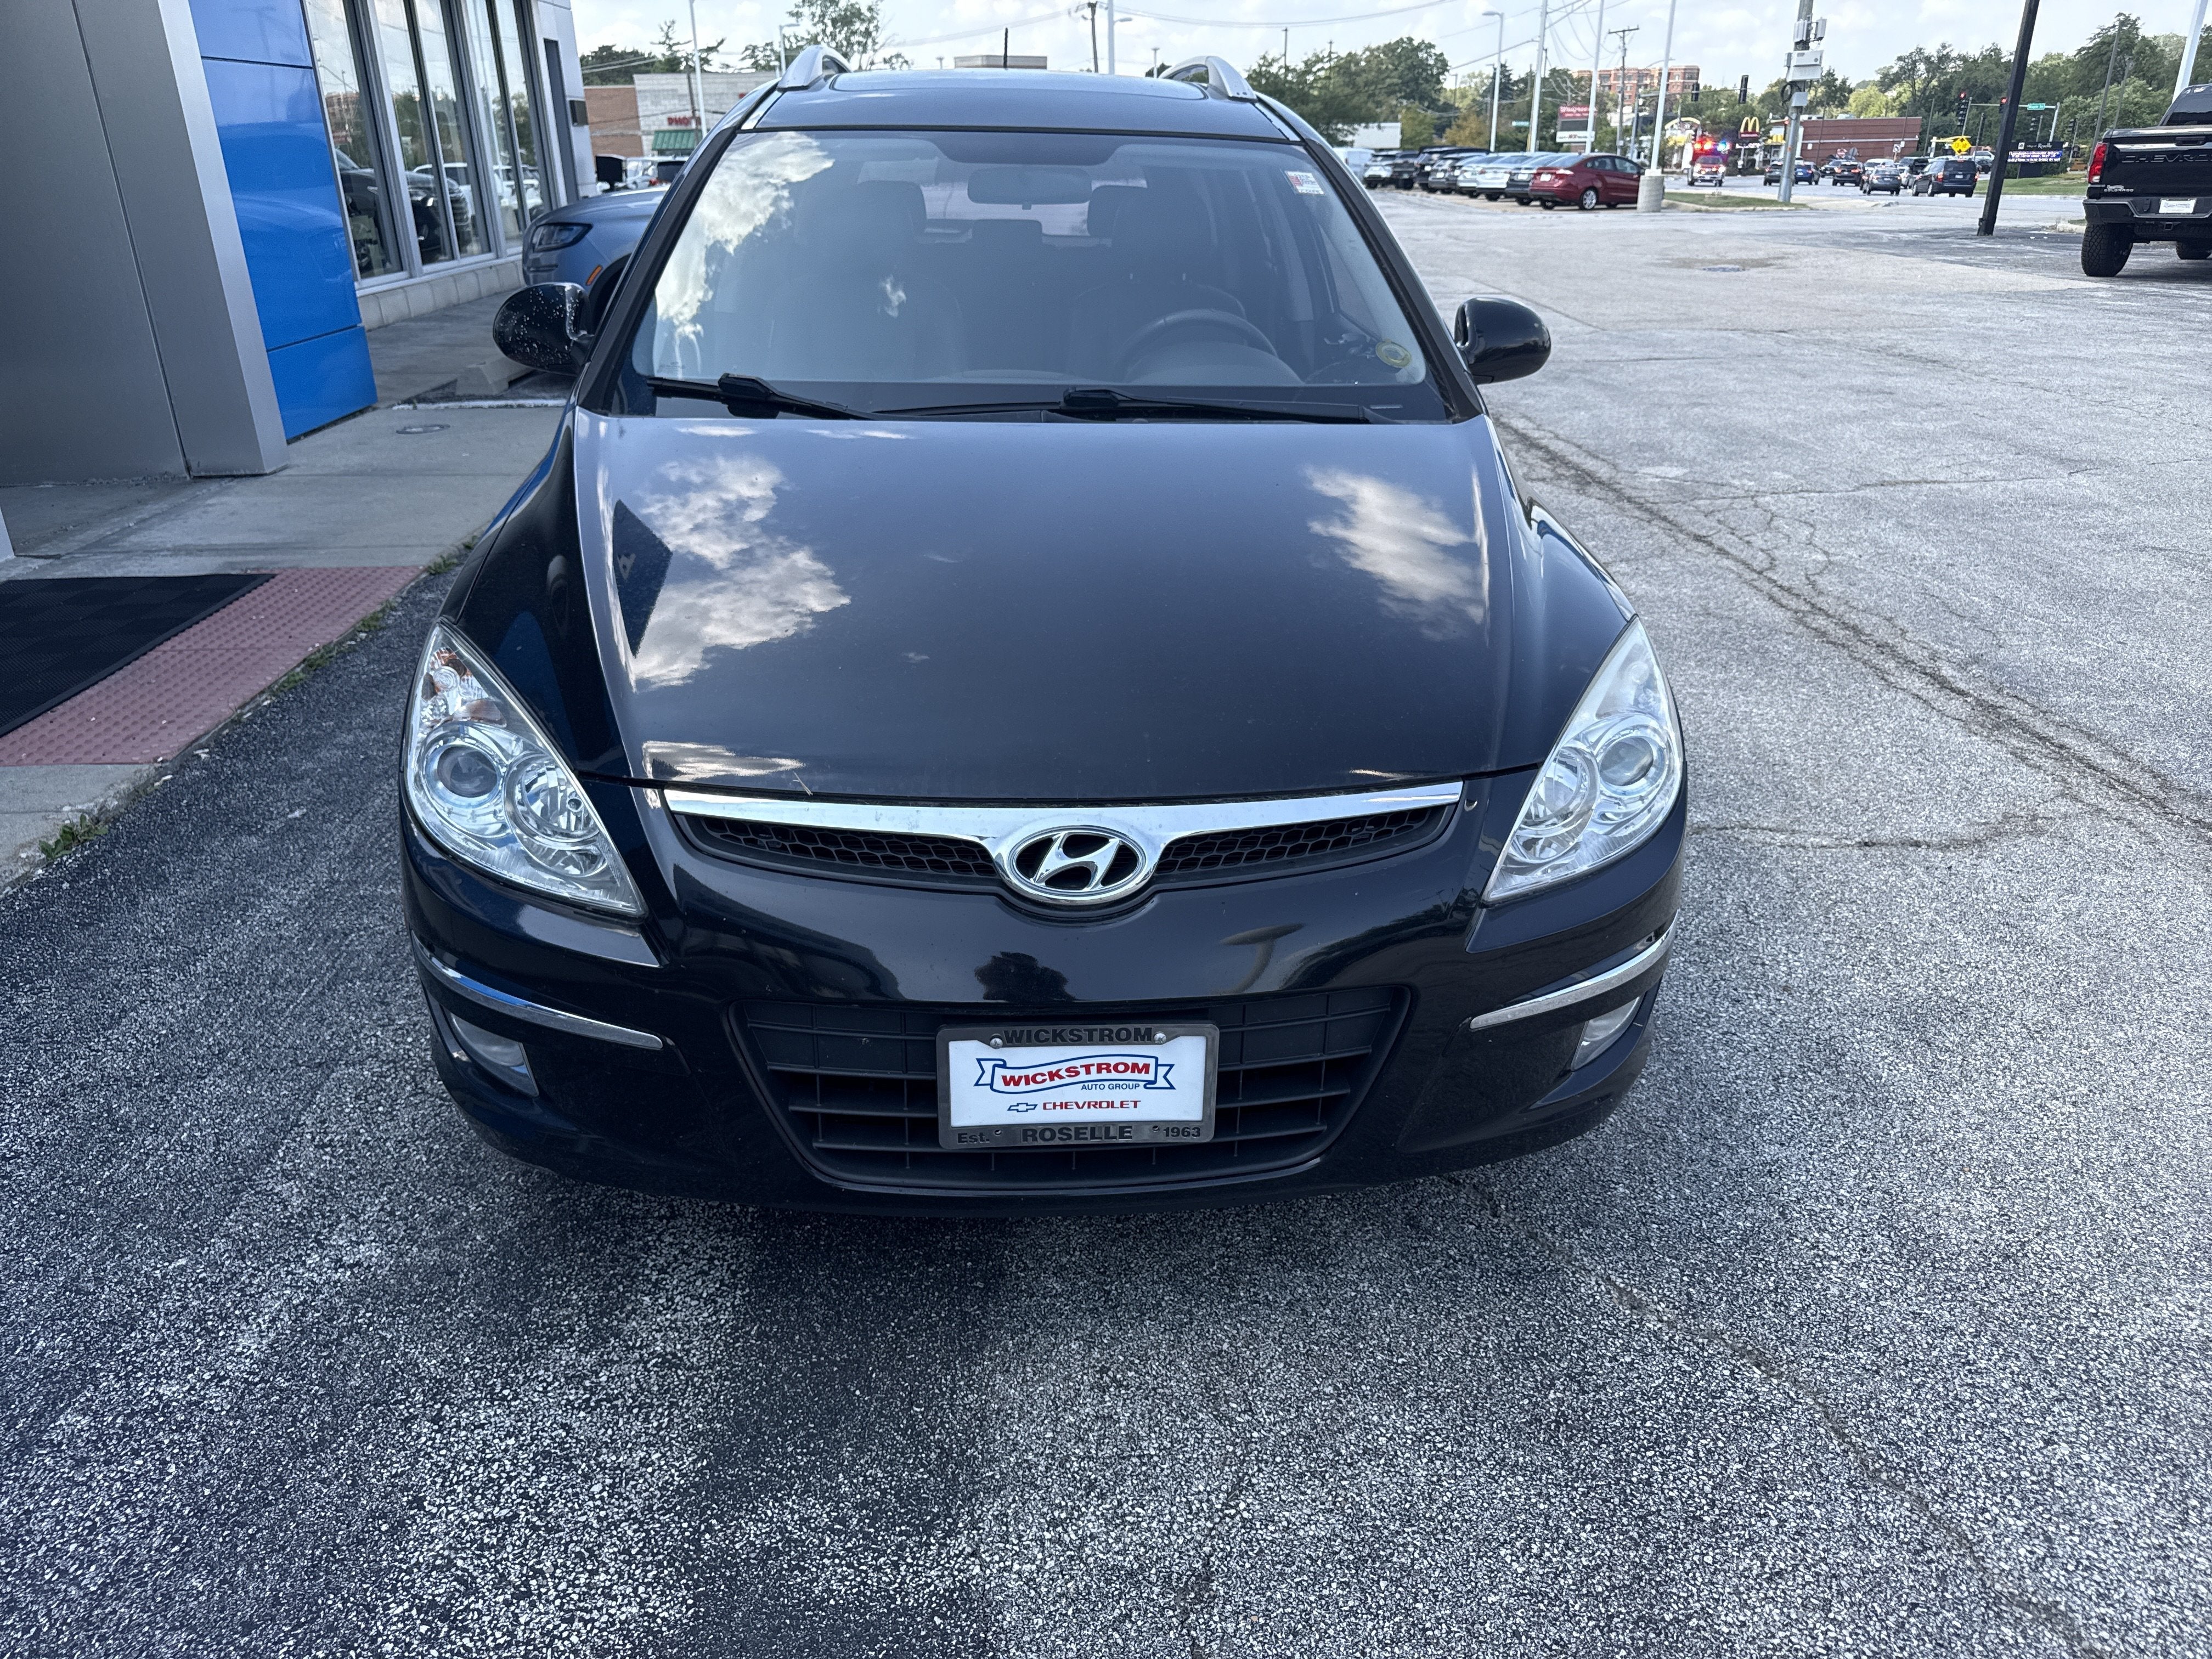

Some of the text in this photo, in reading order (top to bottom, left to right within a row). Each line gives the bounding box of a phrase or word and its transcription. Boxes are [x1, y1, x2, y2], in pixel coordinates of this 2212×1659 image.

[2121, 154, 2212, 163] CHEVRO
[1003, 1028, 1152, 1043] WICKSTROM
[1001, 1062, 1150, 1087] WICKSTROM
[1043, 1100, 1141, 1110] CHEVROLET
[957, 1126, 1201, 1144] Est. ROSELLE 1963
